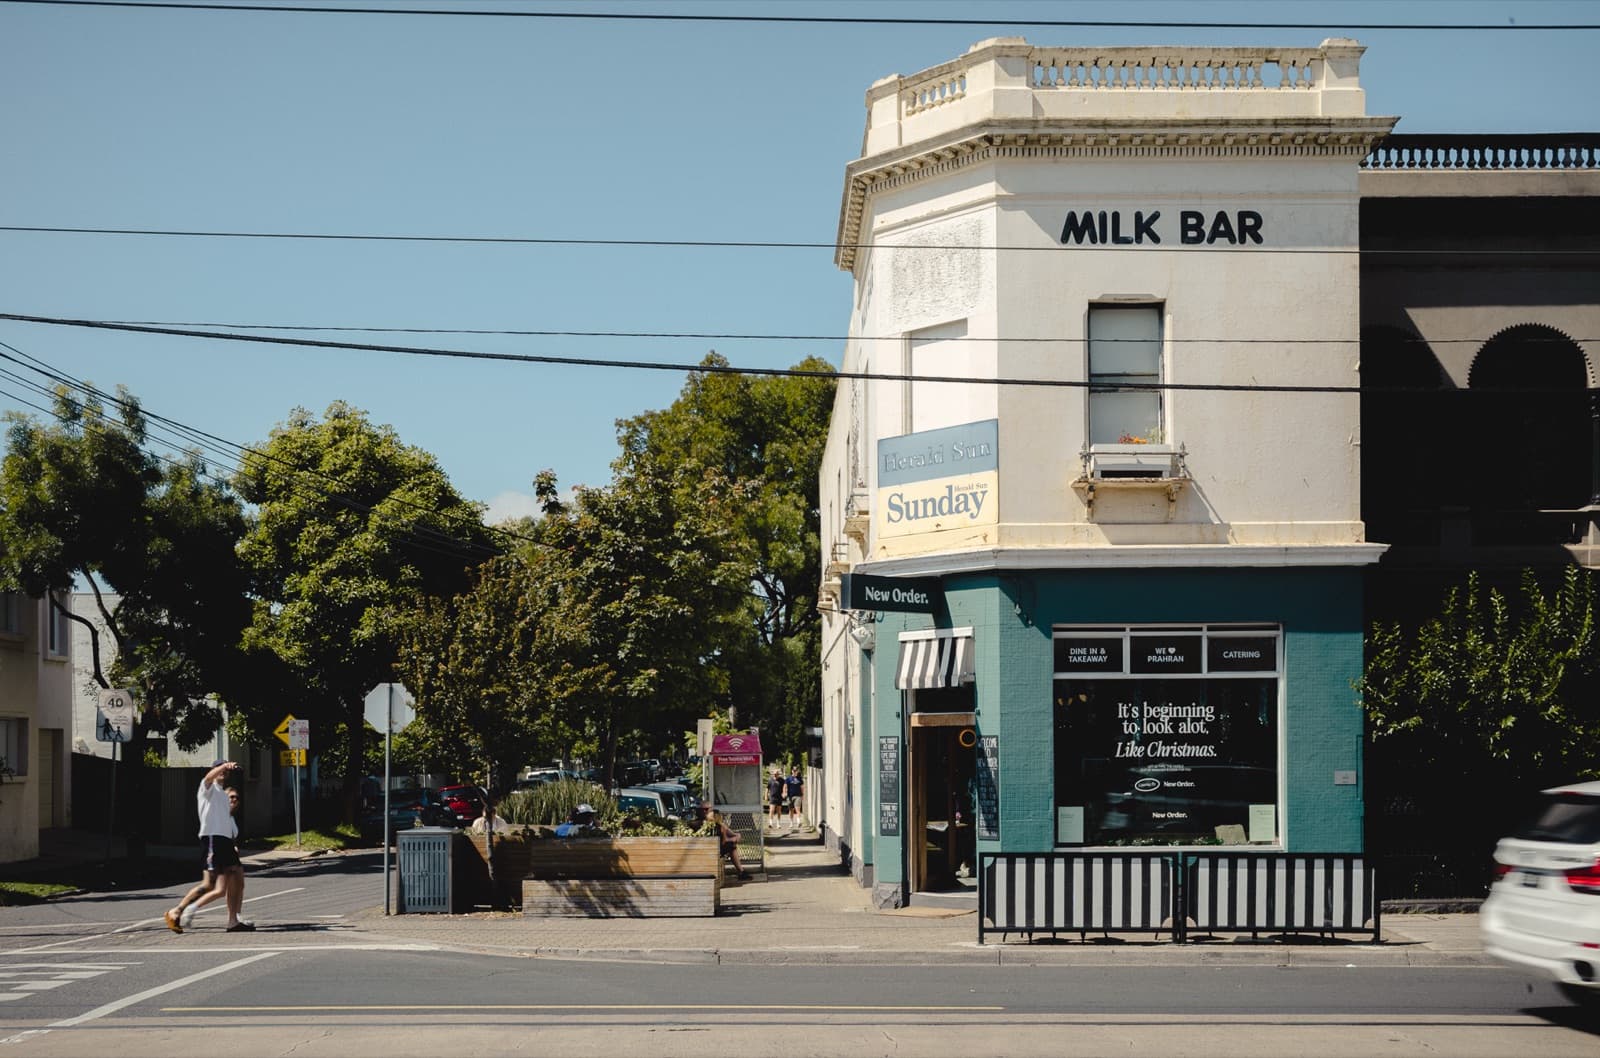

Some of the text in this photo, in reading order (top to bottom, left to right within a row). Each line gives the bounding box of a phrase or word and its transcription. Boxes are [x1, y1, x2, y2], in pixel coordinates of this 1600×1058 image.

[1060, 210, 1264, 245] MILK BAR
[884, 440, 992, 473] Herald Sun
[887, 485, 988, 523] Sunday
[865, 586, 929, 604] New Order.
[1068, 655, 1108, 663] TAKEAWAY
[1070, 647, 1106, 655] DINE IN &
[1147, 655, 1184, 663] PRAHRAN
[1155, 647, 1166, 655] WE
[1223, 651, 1260, 659] CATERING
[107, 697, 124, 708] 40
[1117, 701, 1215, 722] It's beginning
[1122, 719, 1138, 734] to
[1143, 717, 1174, 734] look
[1115, 740, 1217, 758] Like Christmas.
